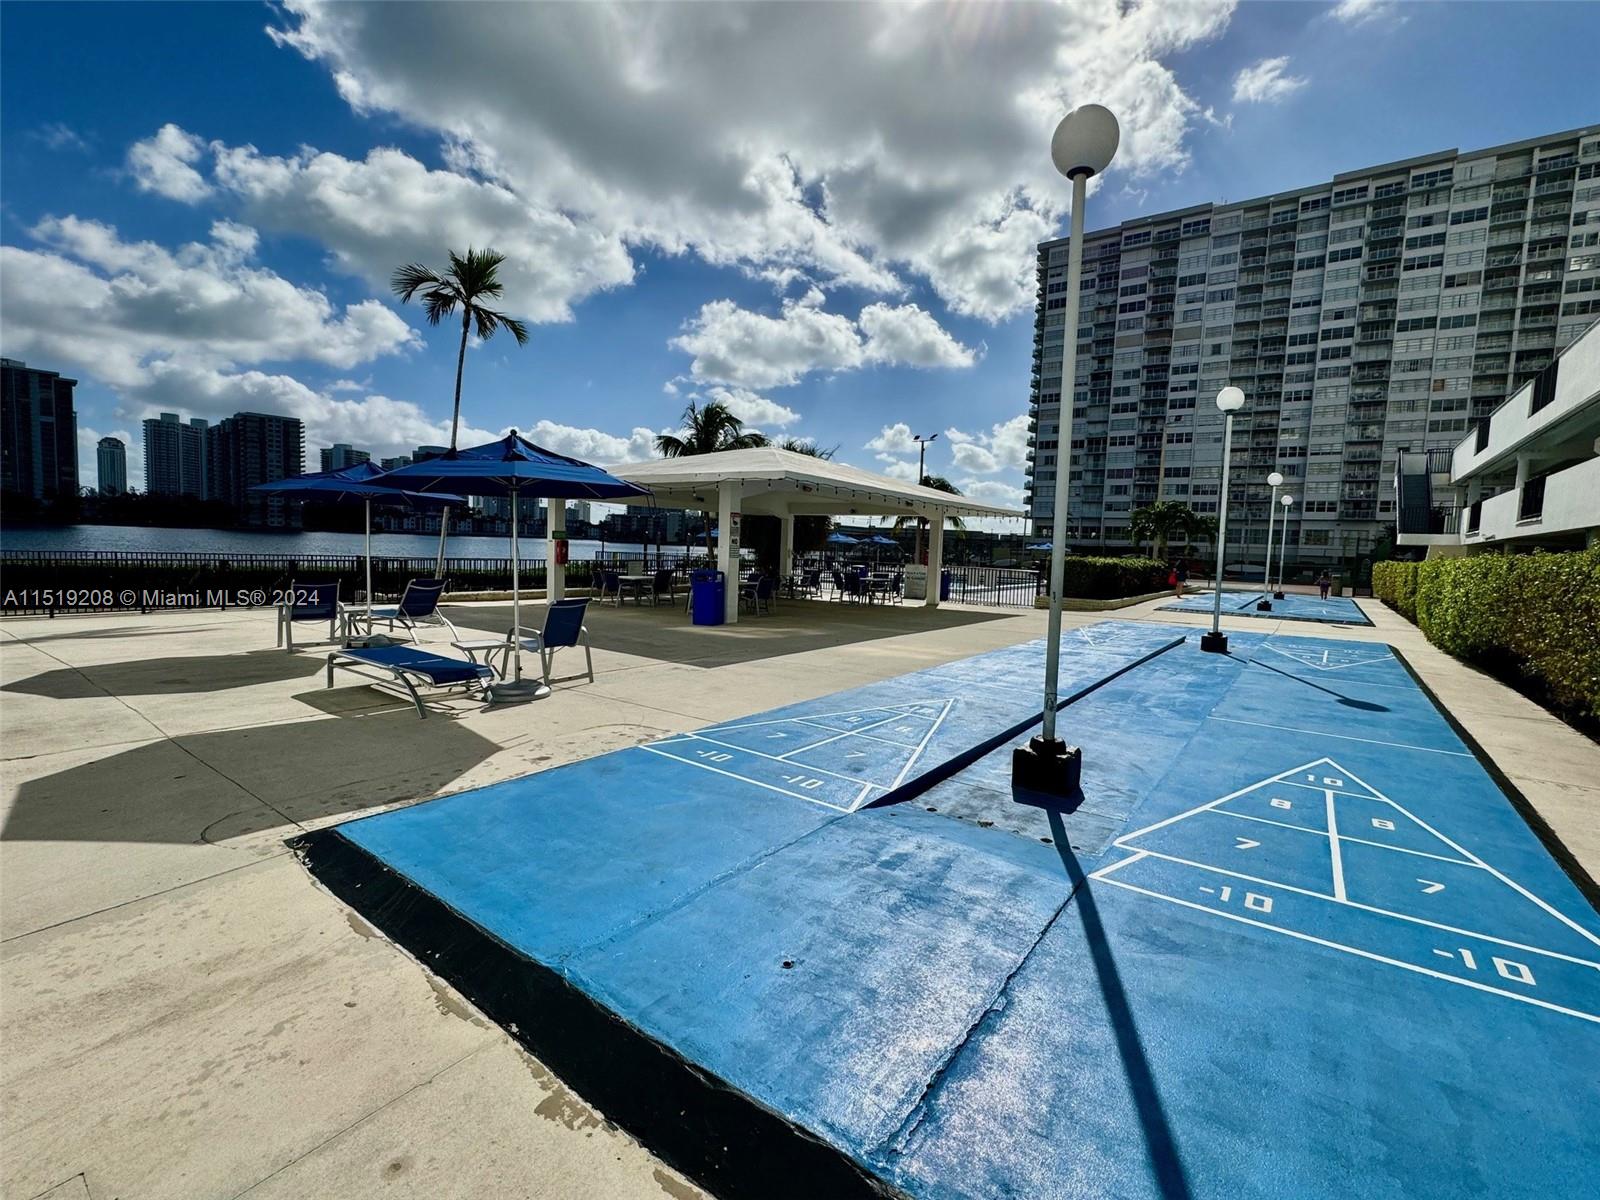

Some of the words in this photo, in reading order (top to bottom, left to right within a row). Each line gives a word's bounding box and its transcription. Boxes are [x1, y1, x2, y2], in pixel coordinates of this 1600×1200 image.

[1306, 774, 1343, 787] 10
[1270, 798, 1292, 810] 8
[1371, 818, 1395, 831] 8
[1234, 837, 1261, 850] 7
[1416, 878, 1445, 894] 7
[1199, 885, 1274, 913] -10
[1432, 948, 1537, 986] -10
